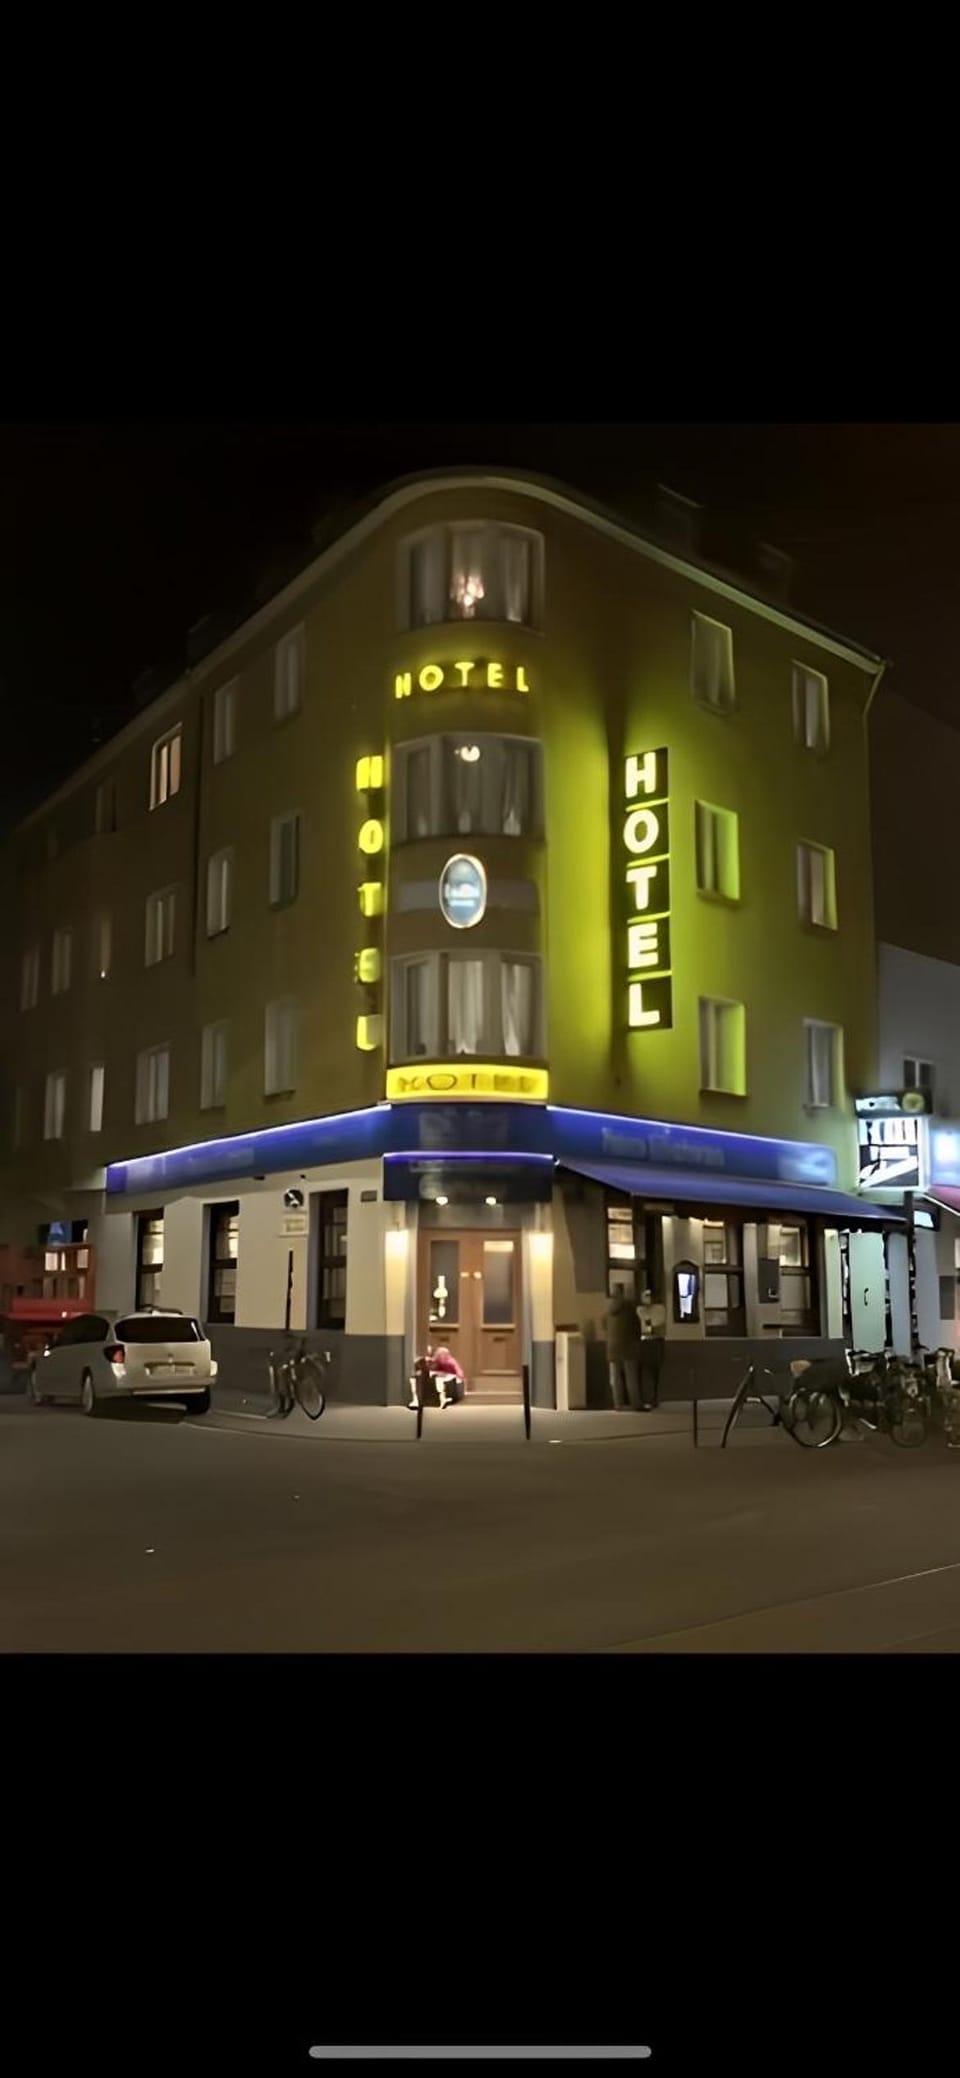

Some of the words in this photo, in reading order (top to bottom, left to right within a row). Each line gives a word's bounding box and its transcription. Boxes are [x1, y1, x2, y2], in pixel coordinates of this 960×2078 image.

[395, 661, 529, 698] HOTEL
[356, 757, 383, 1050] HOTEL
[625, 754, 660, 1026] HOTEL
